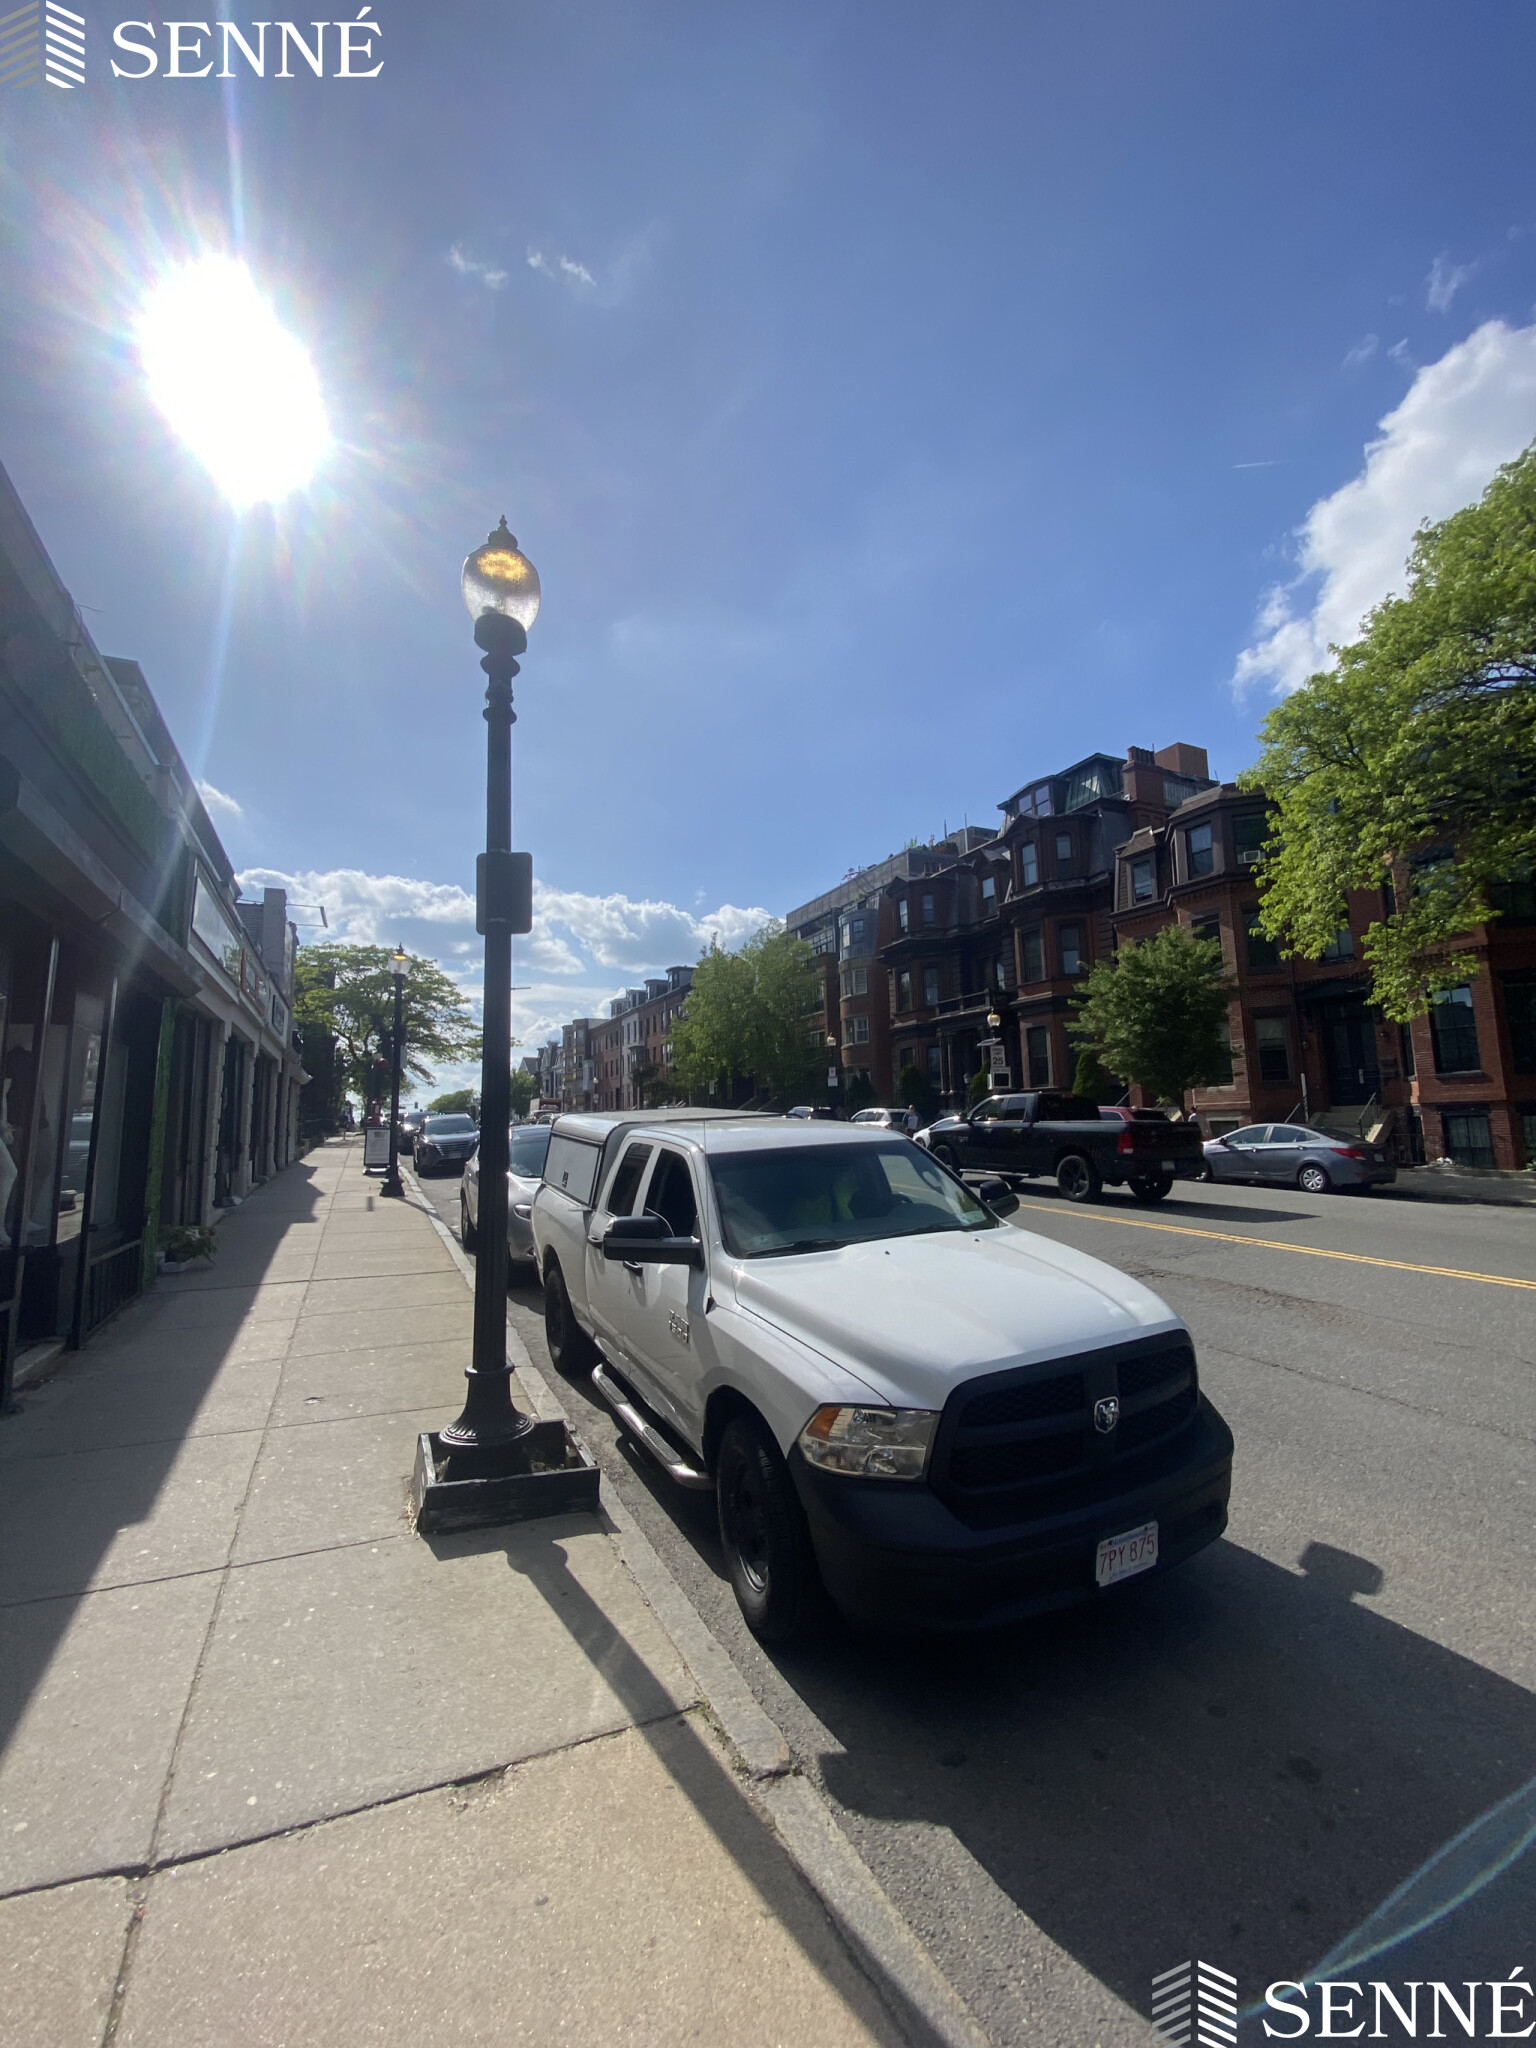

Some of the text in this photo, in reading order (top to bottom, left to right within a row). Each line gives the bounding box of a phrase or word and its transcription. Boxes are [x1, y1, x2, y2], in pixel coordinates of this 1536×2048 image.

[992, 1057, 1003, 1065] 25
[1100, 1544, 1126, 1575] 7PY
[1129, 1534, 1155, 1561] 875
